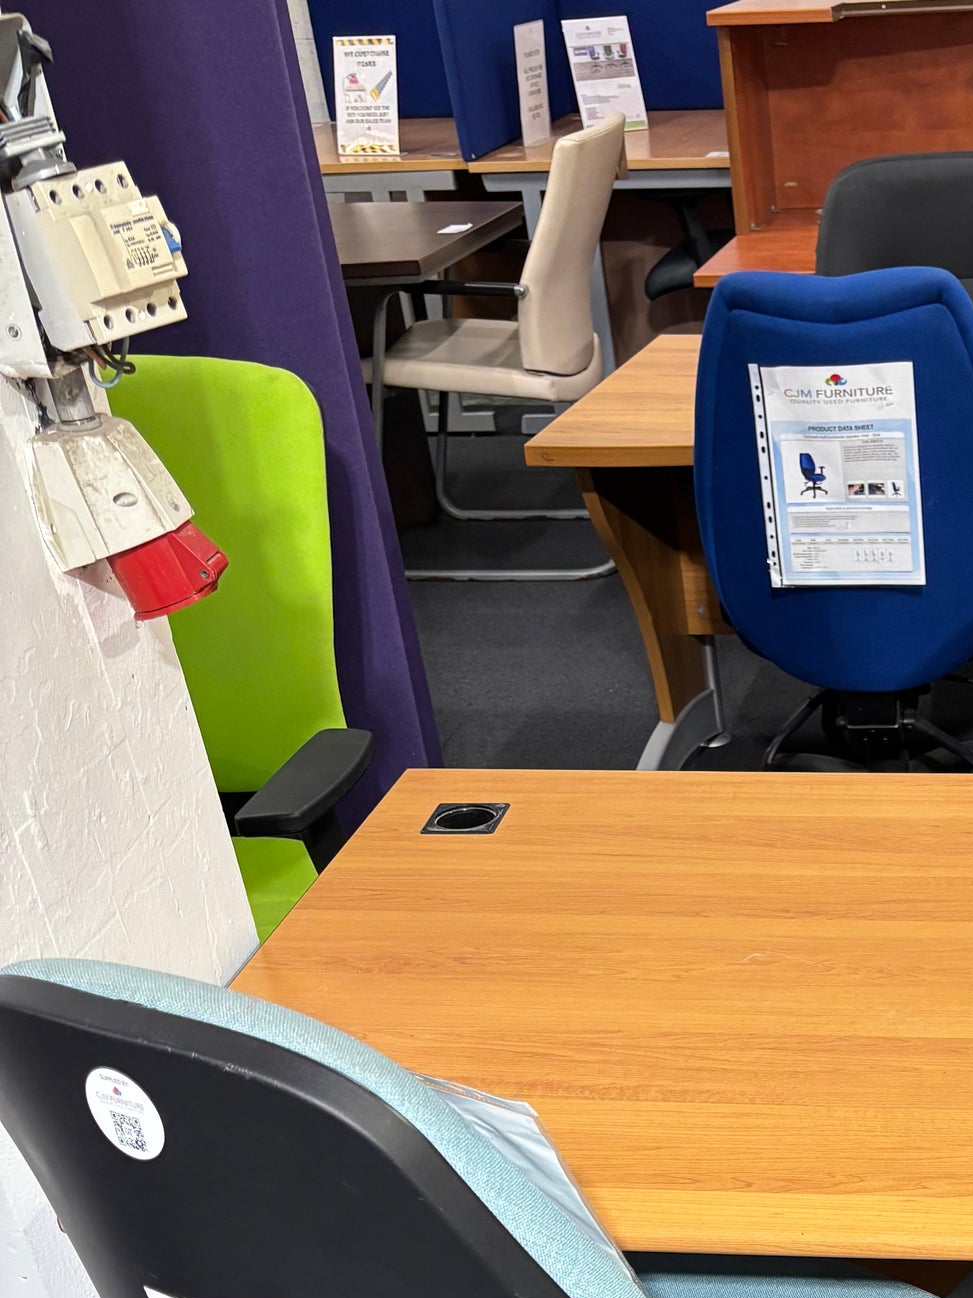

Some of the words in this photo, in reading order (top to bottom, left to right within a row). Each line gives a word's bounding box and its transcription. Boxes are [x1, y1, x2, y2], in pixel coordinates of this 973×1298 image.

[784, 389, 812, 399] CJM
[816, 386, 893, 399] FURNITURE
[845, 396, 887, 404] FURNITURE
